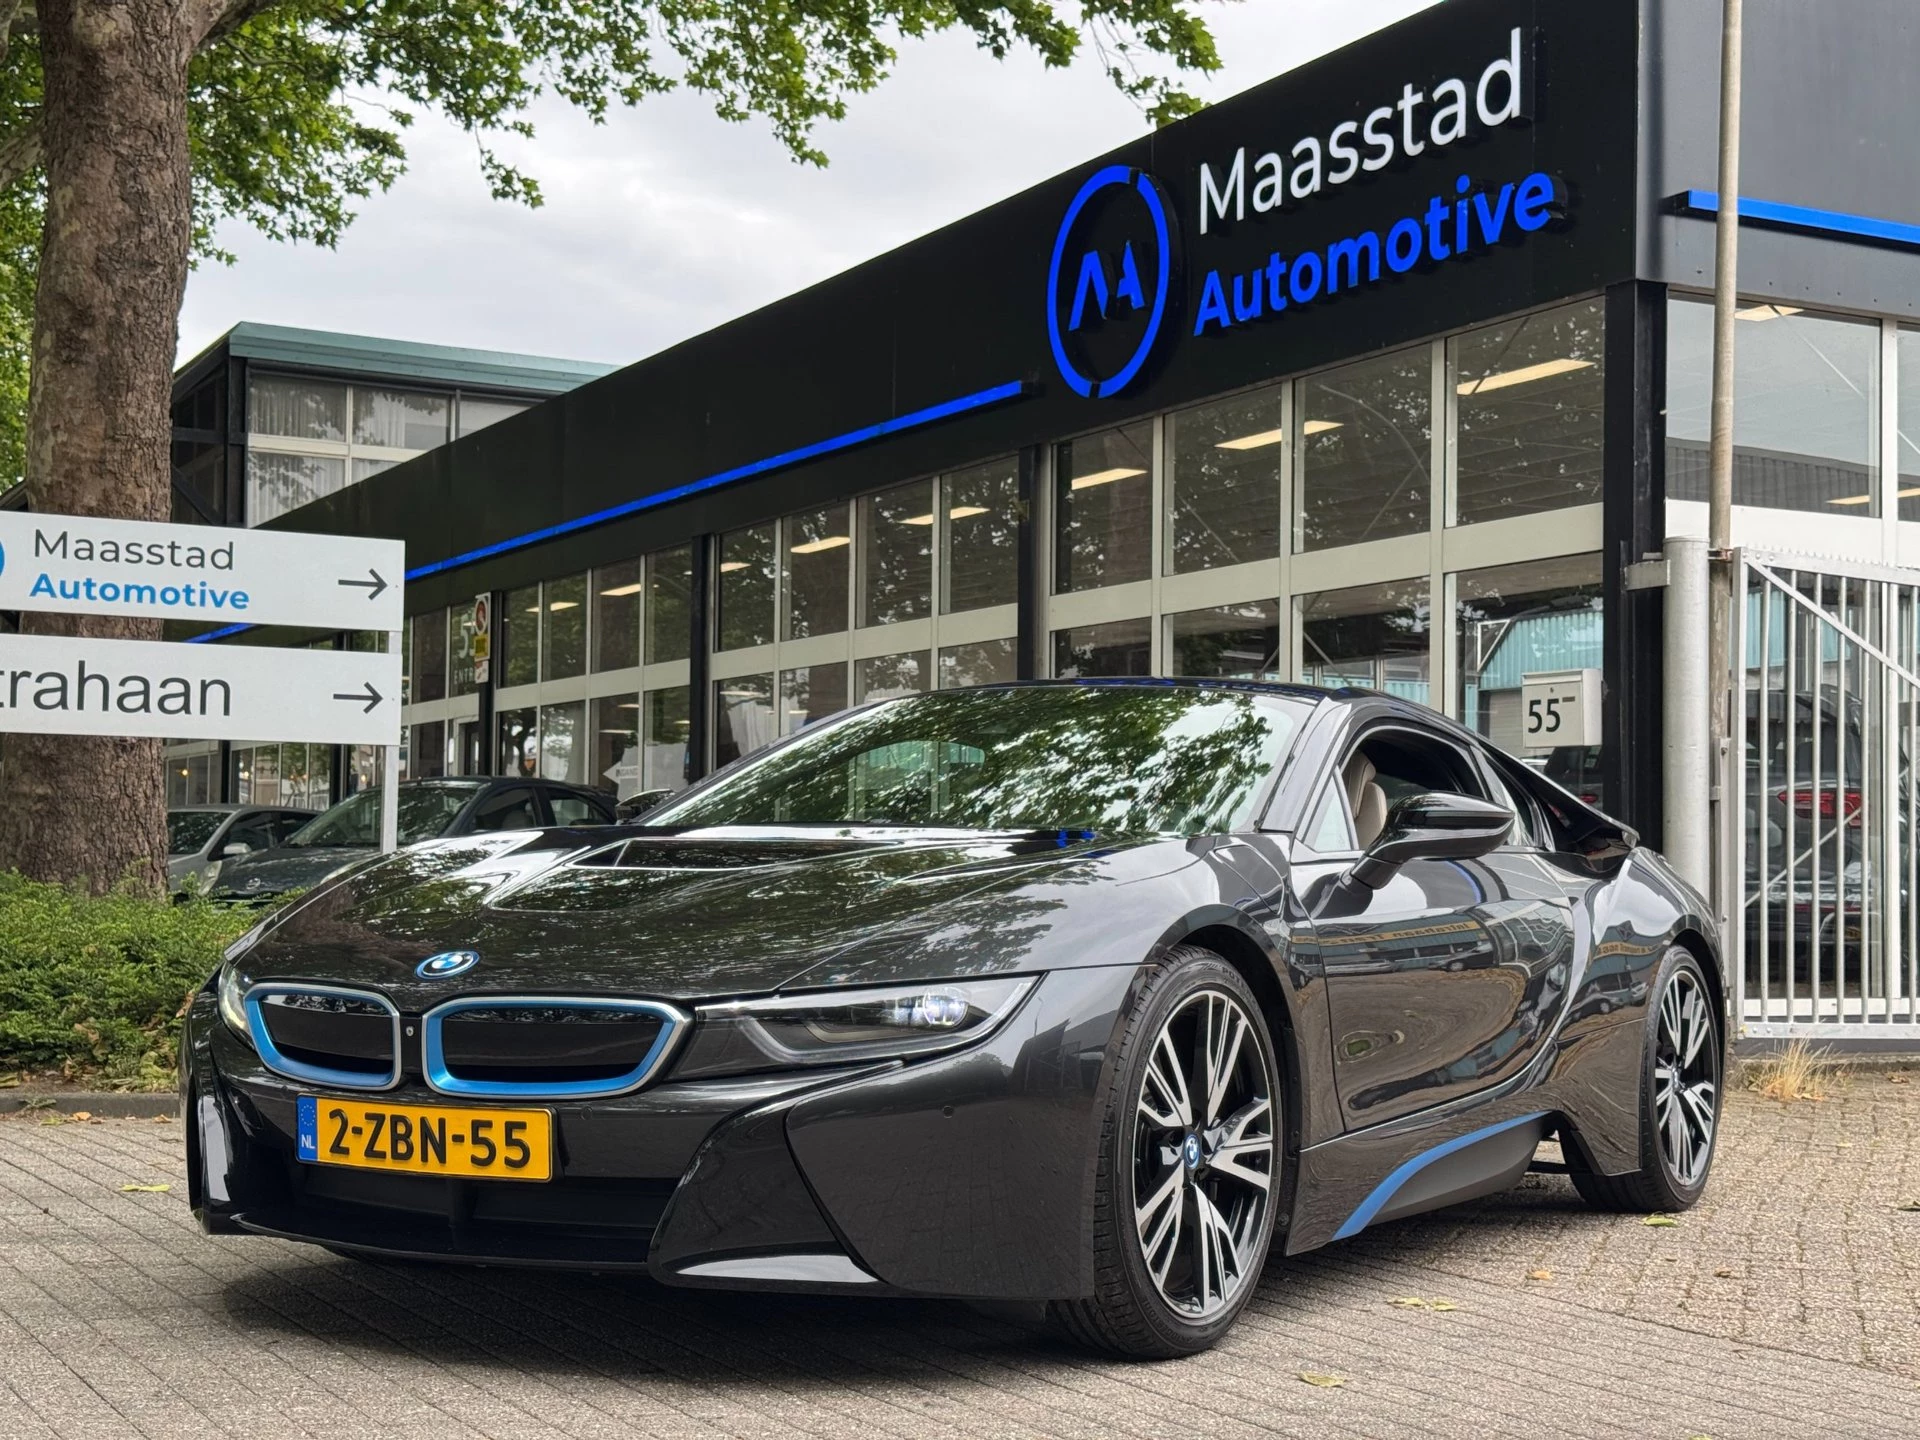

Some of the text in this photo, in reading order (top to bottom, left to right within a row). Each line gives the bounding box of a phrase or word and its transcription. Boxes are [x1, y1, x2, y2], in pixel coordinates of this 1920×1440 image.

[1199, 27, 1522, 236] Maasstad
[1194, 172, 1556, 337] Automotive
[34, 528, 234, 571] Maasstad
[29, 573, 250, 611] Automotive
[0, 660, 232, 717] rahaan
[1527, 698, 1561, 734] 55
[301, 1134, 316, 1150] NL
[328, 1108, 531, 1169] 2-ZBN-55
